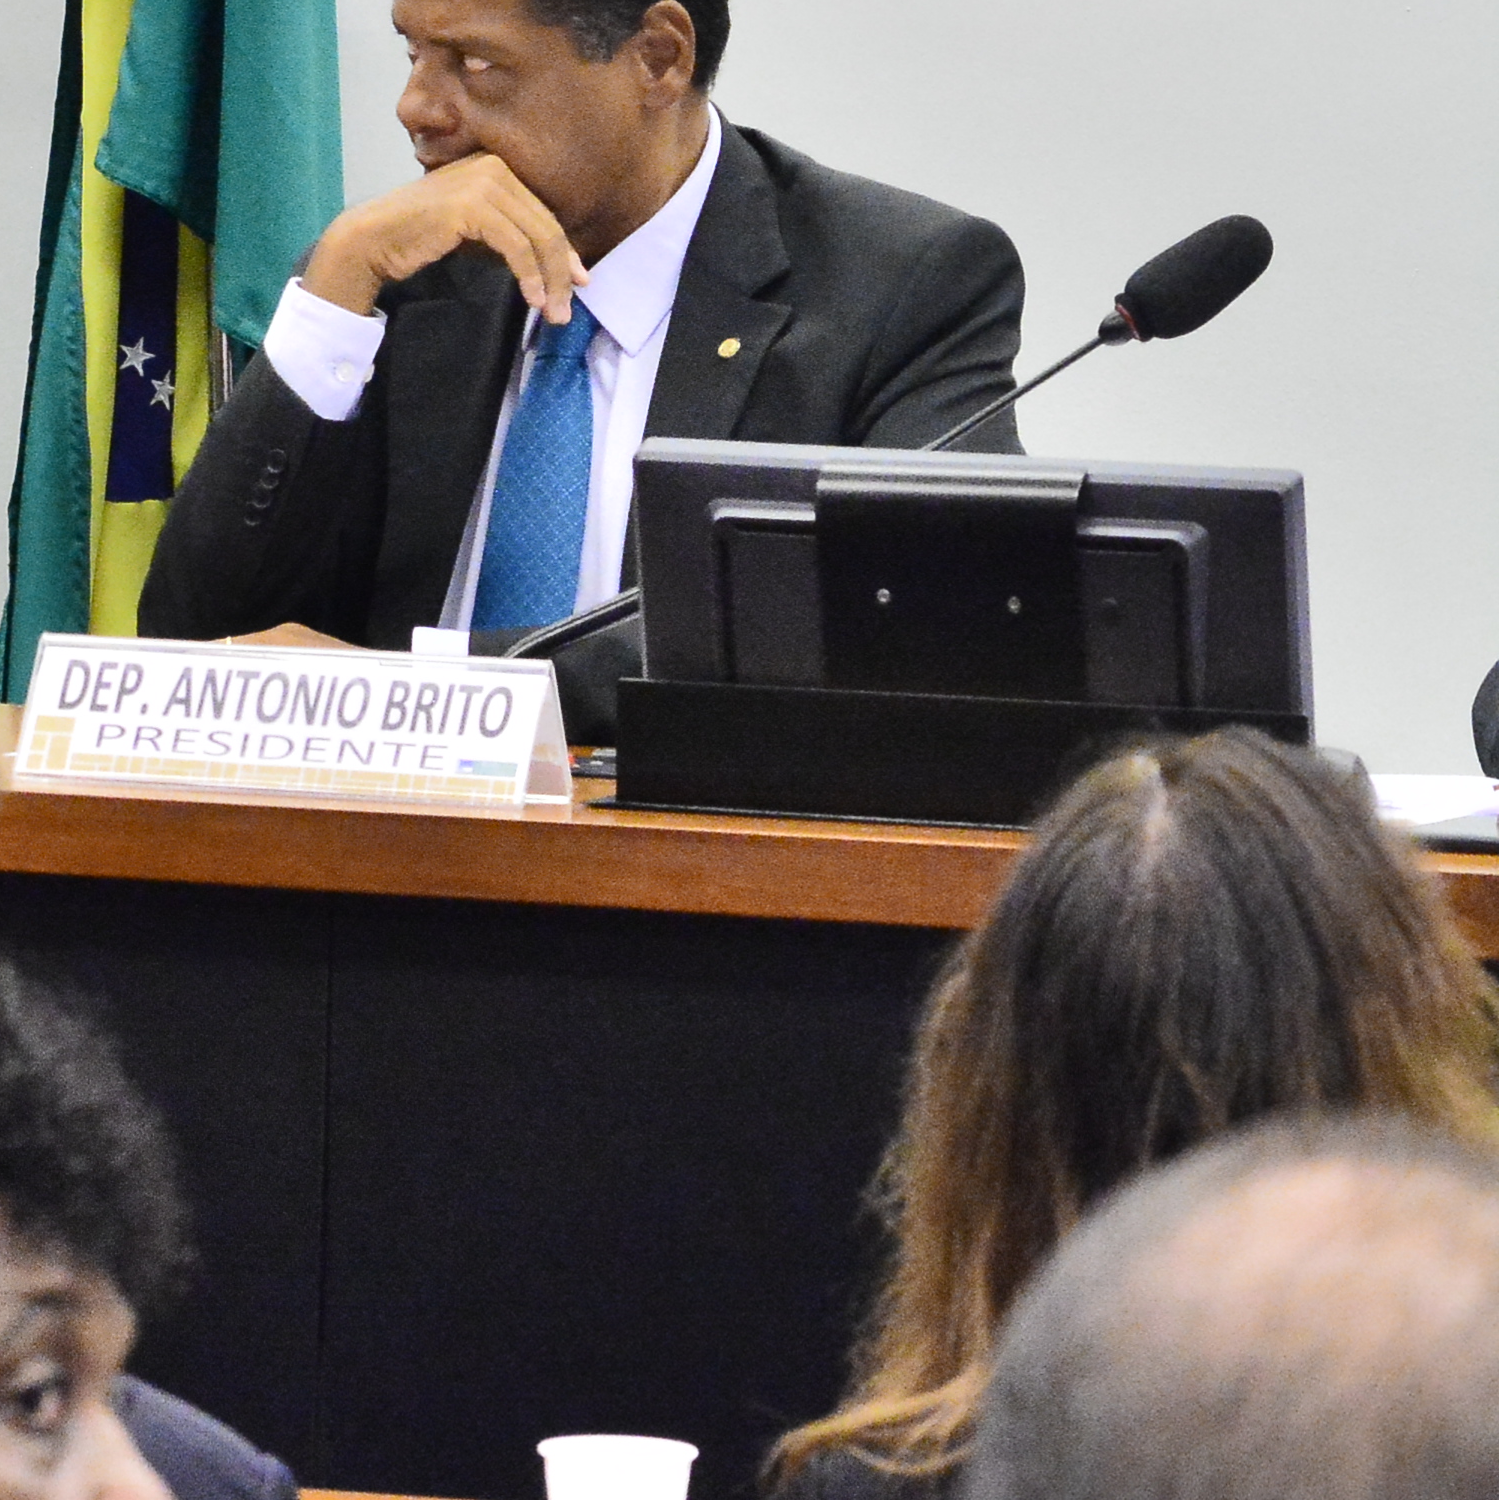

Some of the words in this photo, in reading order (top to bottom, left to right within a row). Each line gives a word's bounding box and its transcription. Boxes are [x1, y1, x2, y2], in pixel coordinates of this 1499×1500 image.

[57, 658, 150, 716] DEP.
[162, 666, 373, 729] ANTONIO
[381, 679, 515, 739] BRITO
[95, 723, 450, 772] PRESIDENTE
